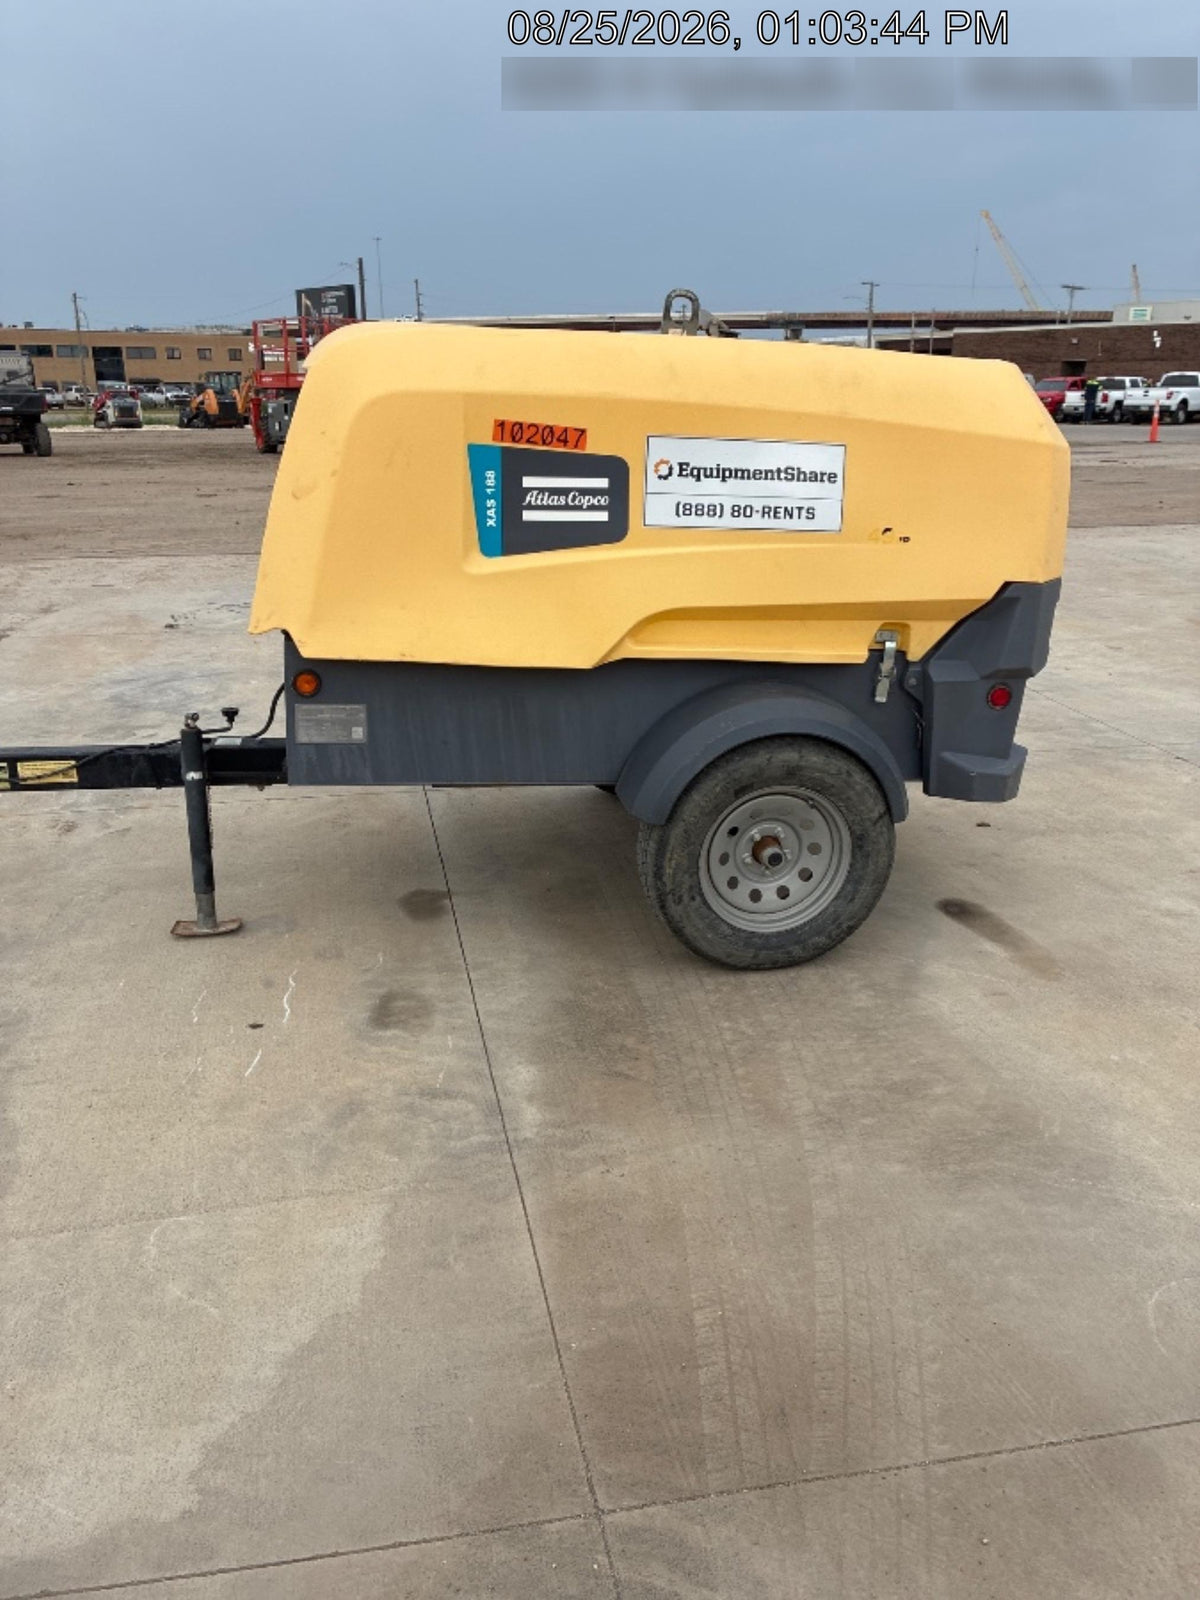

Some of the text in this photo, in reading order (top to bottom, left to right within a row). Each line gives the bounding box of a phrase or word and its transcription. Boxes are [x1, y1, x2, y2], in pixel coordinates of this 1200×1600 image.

[496, 421, 586, 449] 102047
[677, 462, 838, 484] EquipmentShare
[485, 470, 497, 527] XAS 188
[522, 490, 610, 509] Atlas Copco
[675, 501, 816, 520] (888) 80-RENTS
